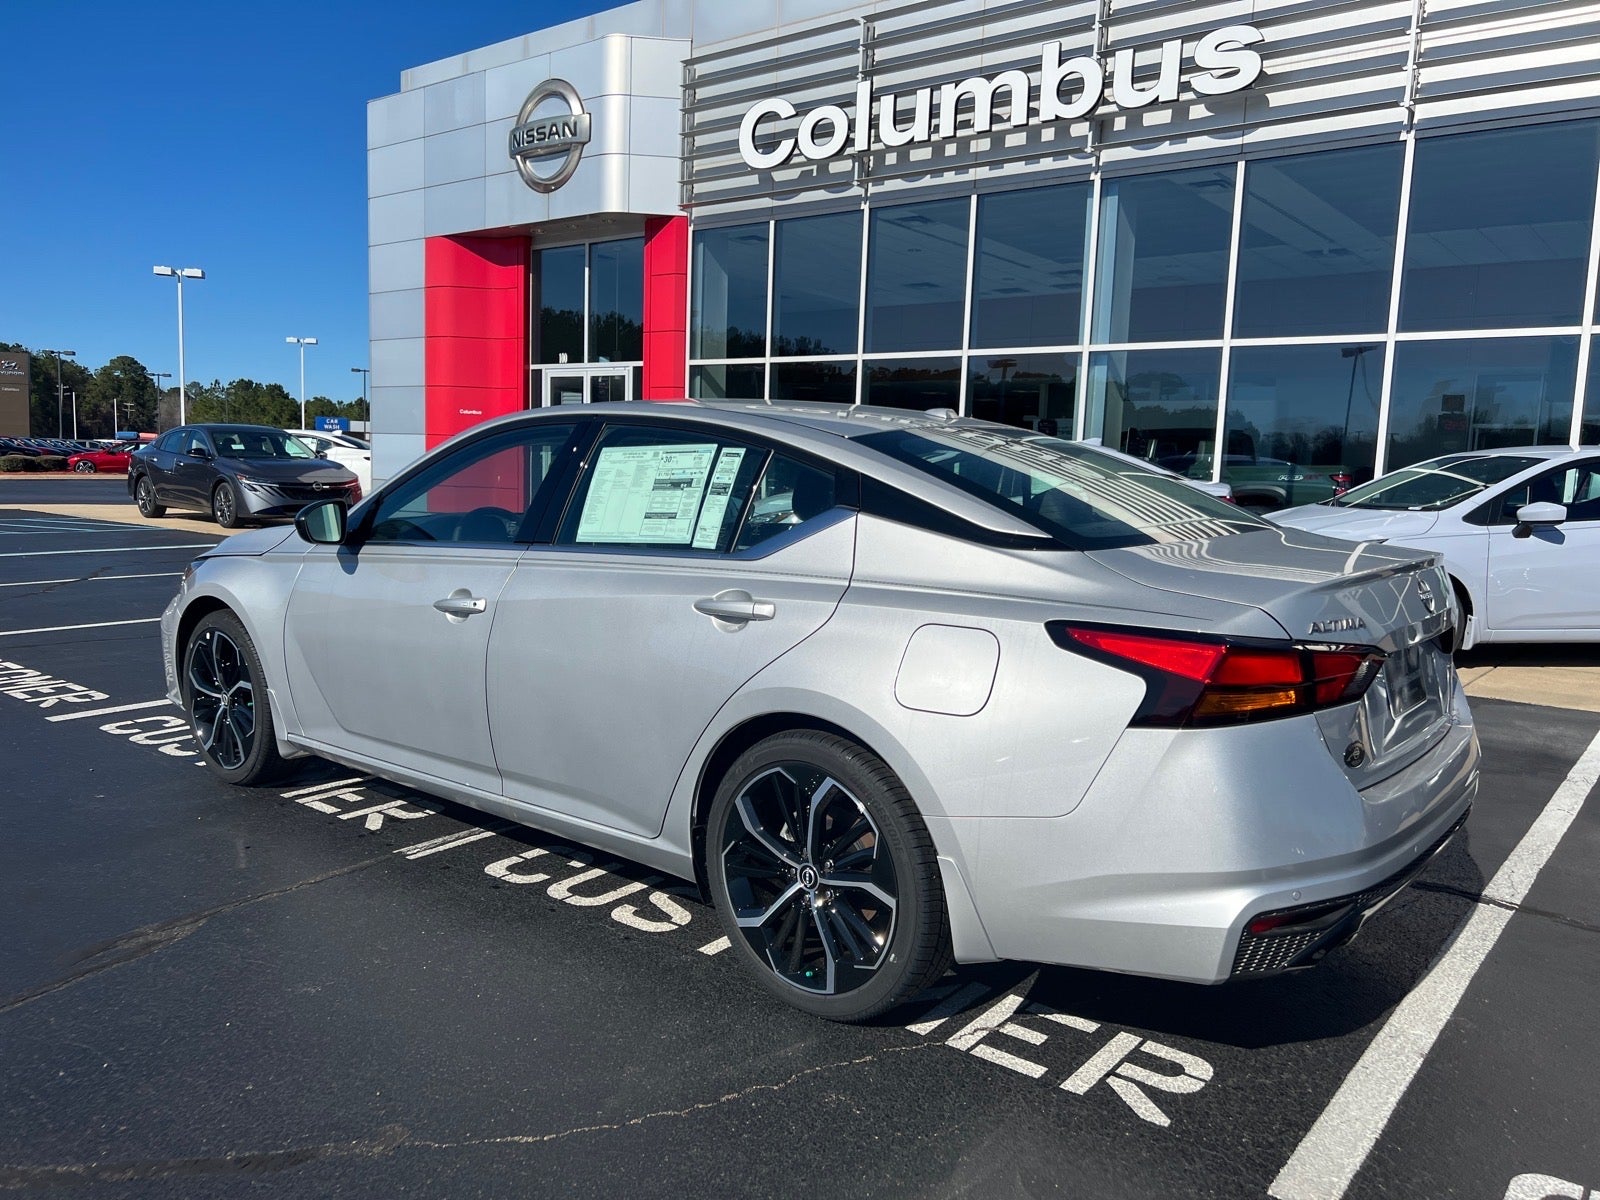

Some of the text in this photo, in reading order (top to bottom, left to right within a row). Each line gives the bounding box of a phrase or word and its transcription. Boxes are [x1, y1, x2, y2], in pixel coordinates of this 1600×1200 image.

[738, 24, 1265, 169] Columbus
[511, 120, 578, 150] NISSAN
[1308, 616, 1367, 636] ALTIMA
